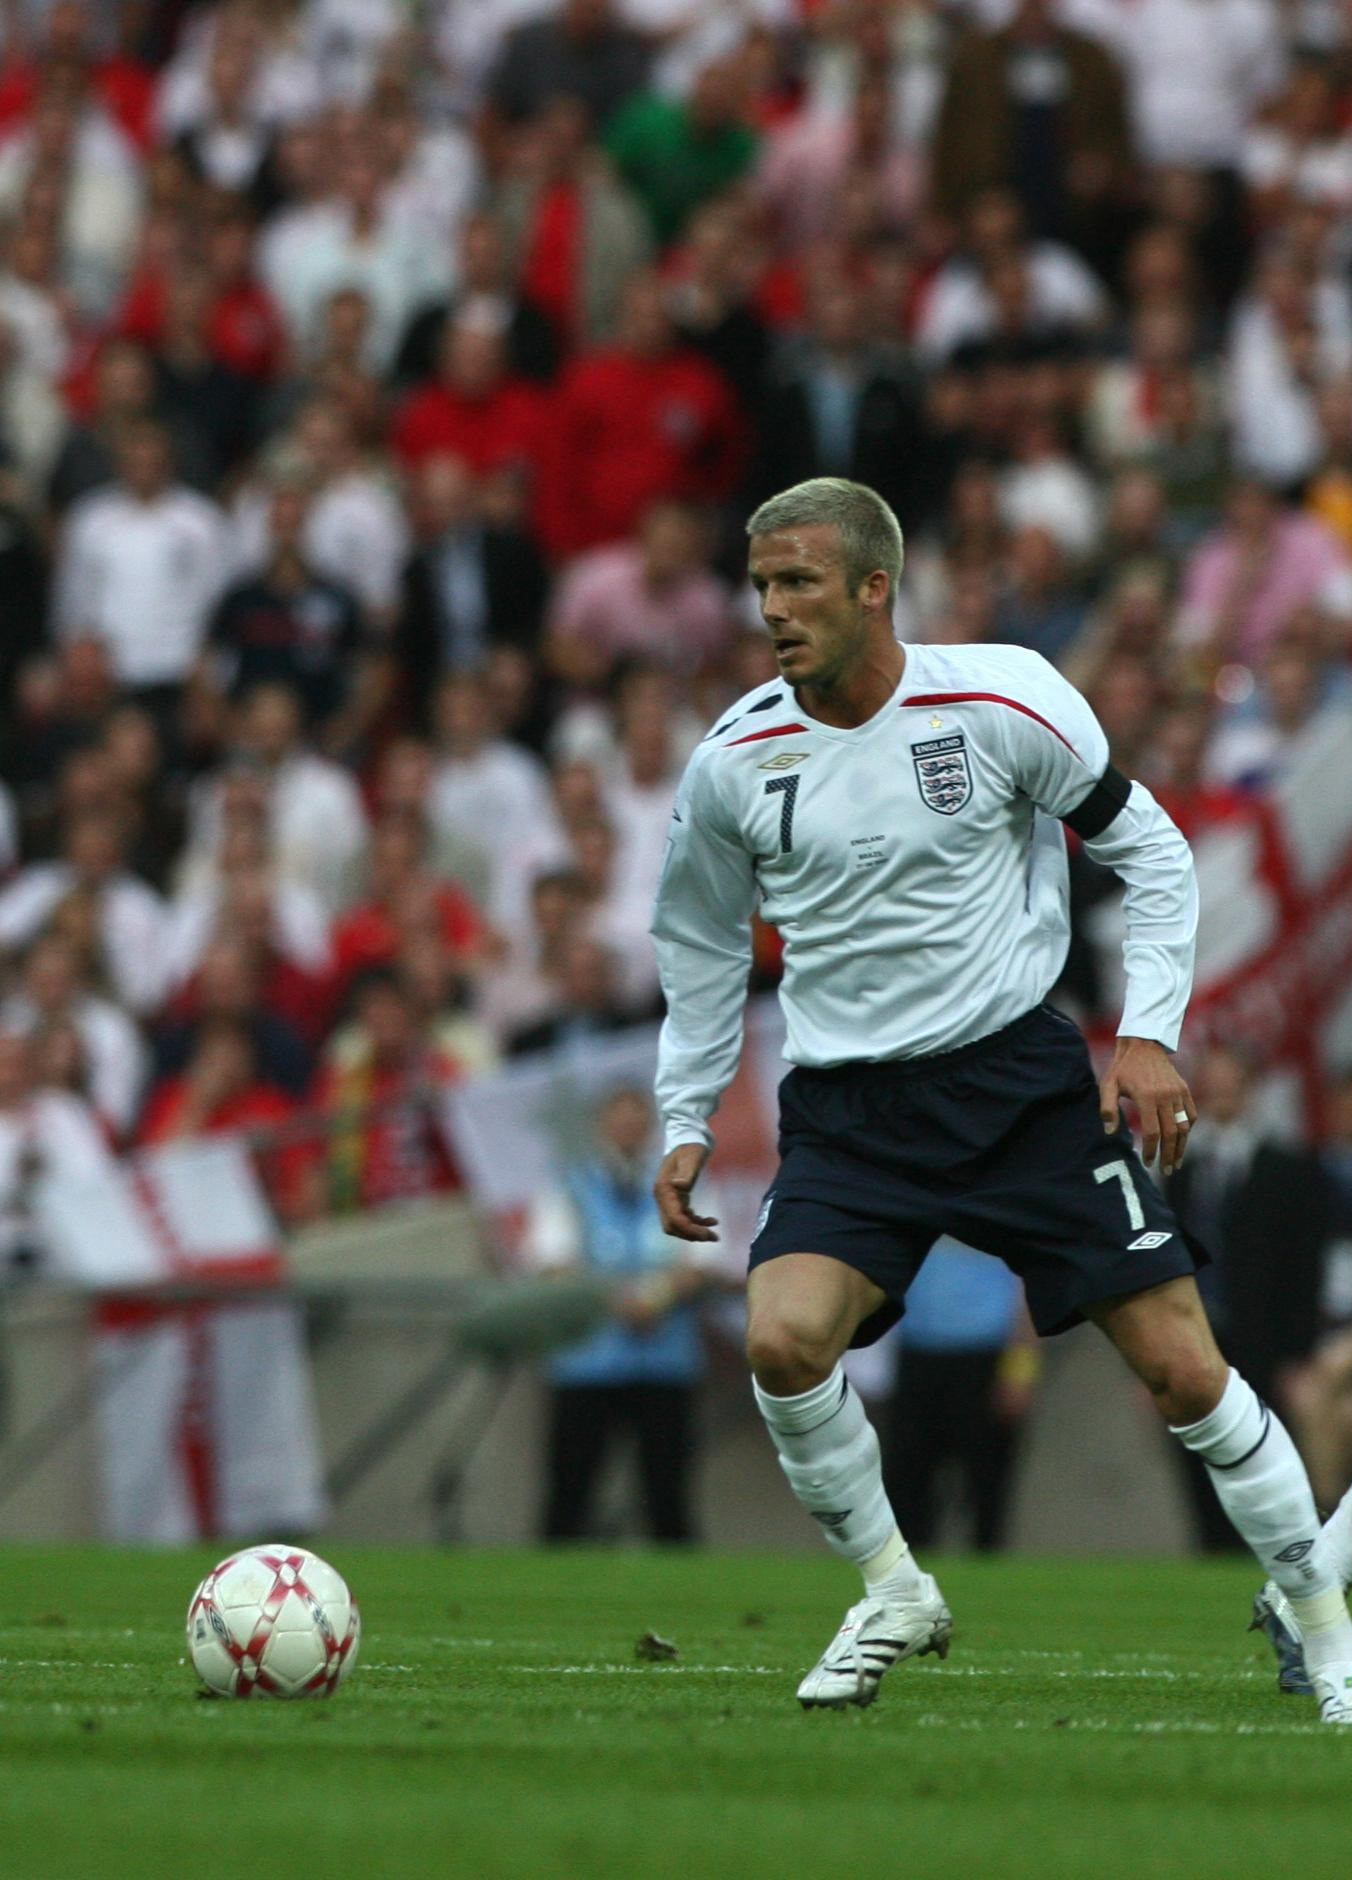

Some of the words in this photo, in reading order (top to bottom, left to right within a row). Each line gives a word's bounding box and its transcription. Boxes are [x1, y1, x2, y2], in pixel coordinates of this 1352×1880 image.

[914, 738, 961, 754] ENGLAND
[764, 774, 801, 853] 7
[1093, 1159, 1146, 1231] 7
